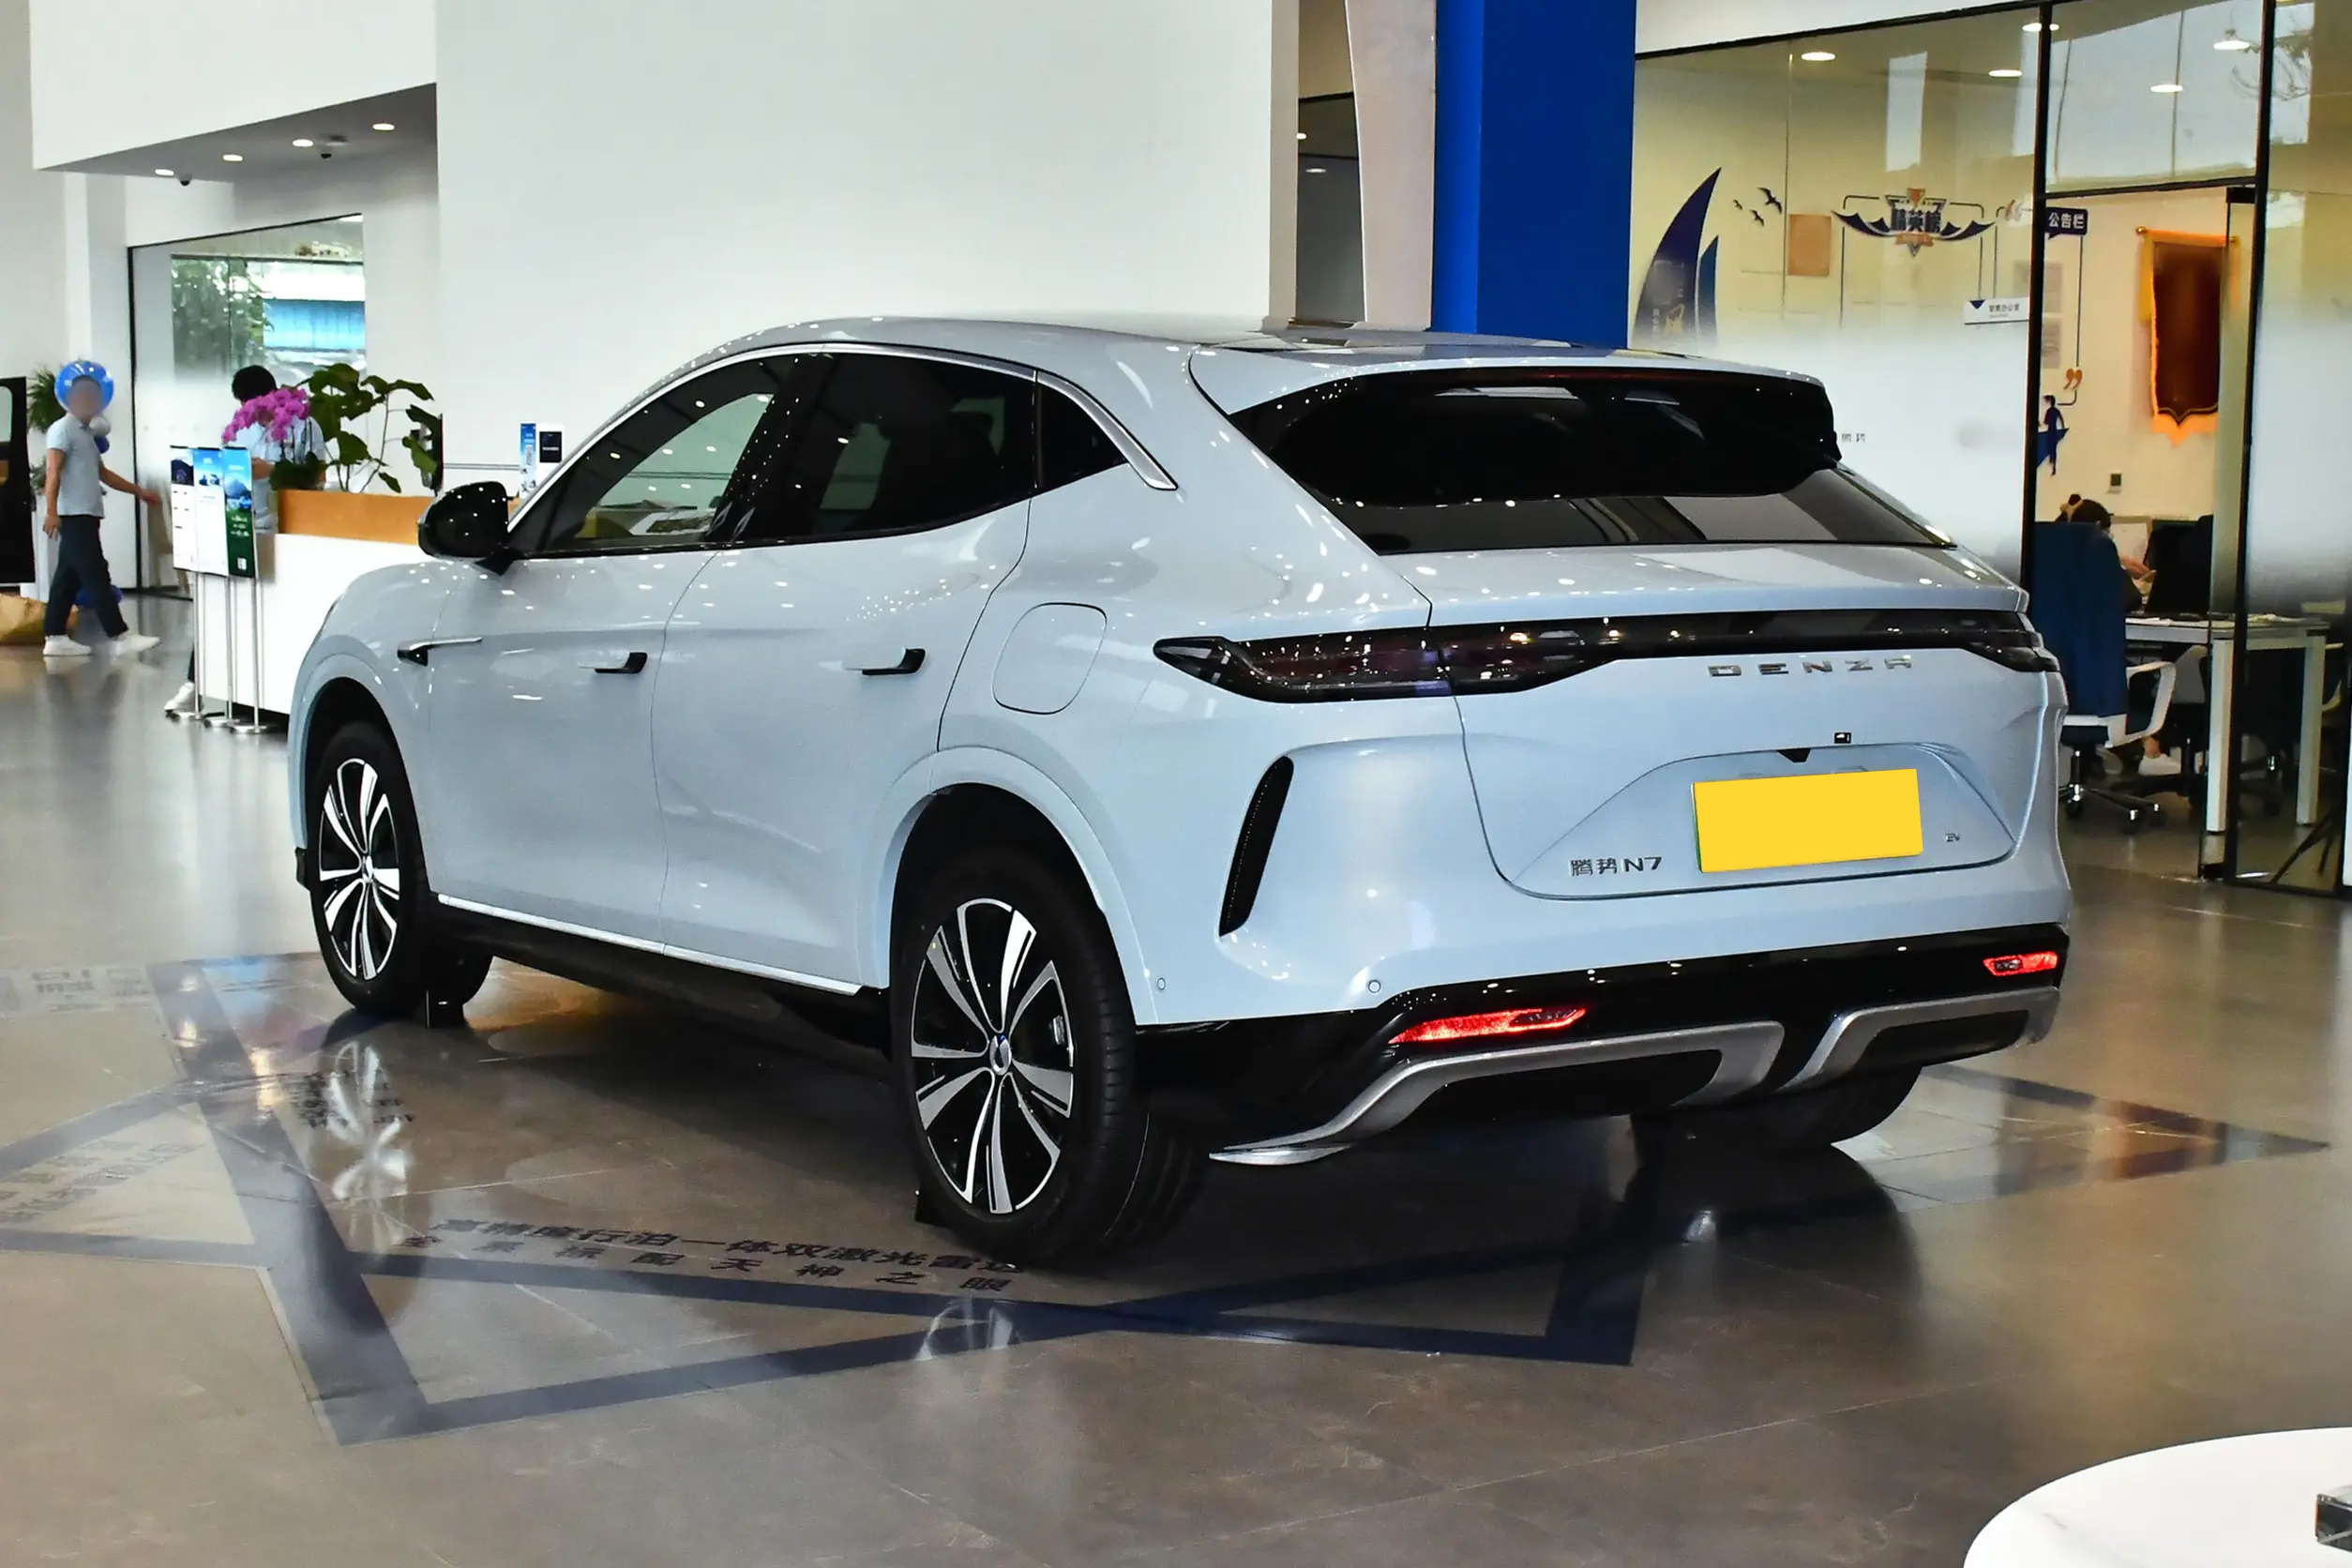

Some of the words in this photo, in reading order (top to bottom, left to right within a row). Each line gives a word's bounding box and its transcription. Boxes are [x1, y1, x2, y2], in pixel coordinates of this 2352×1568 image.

[2048, 212, 2084, 229] 公告栏
[1708, 656, 1912, 678] DENZA
